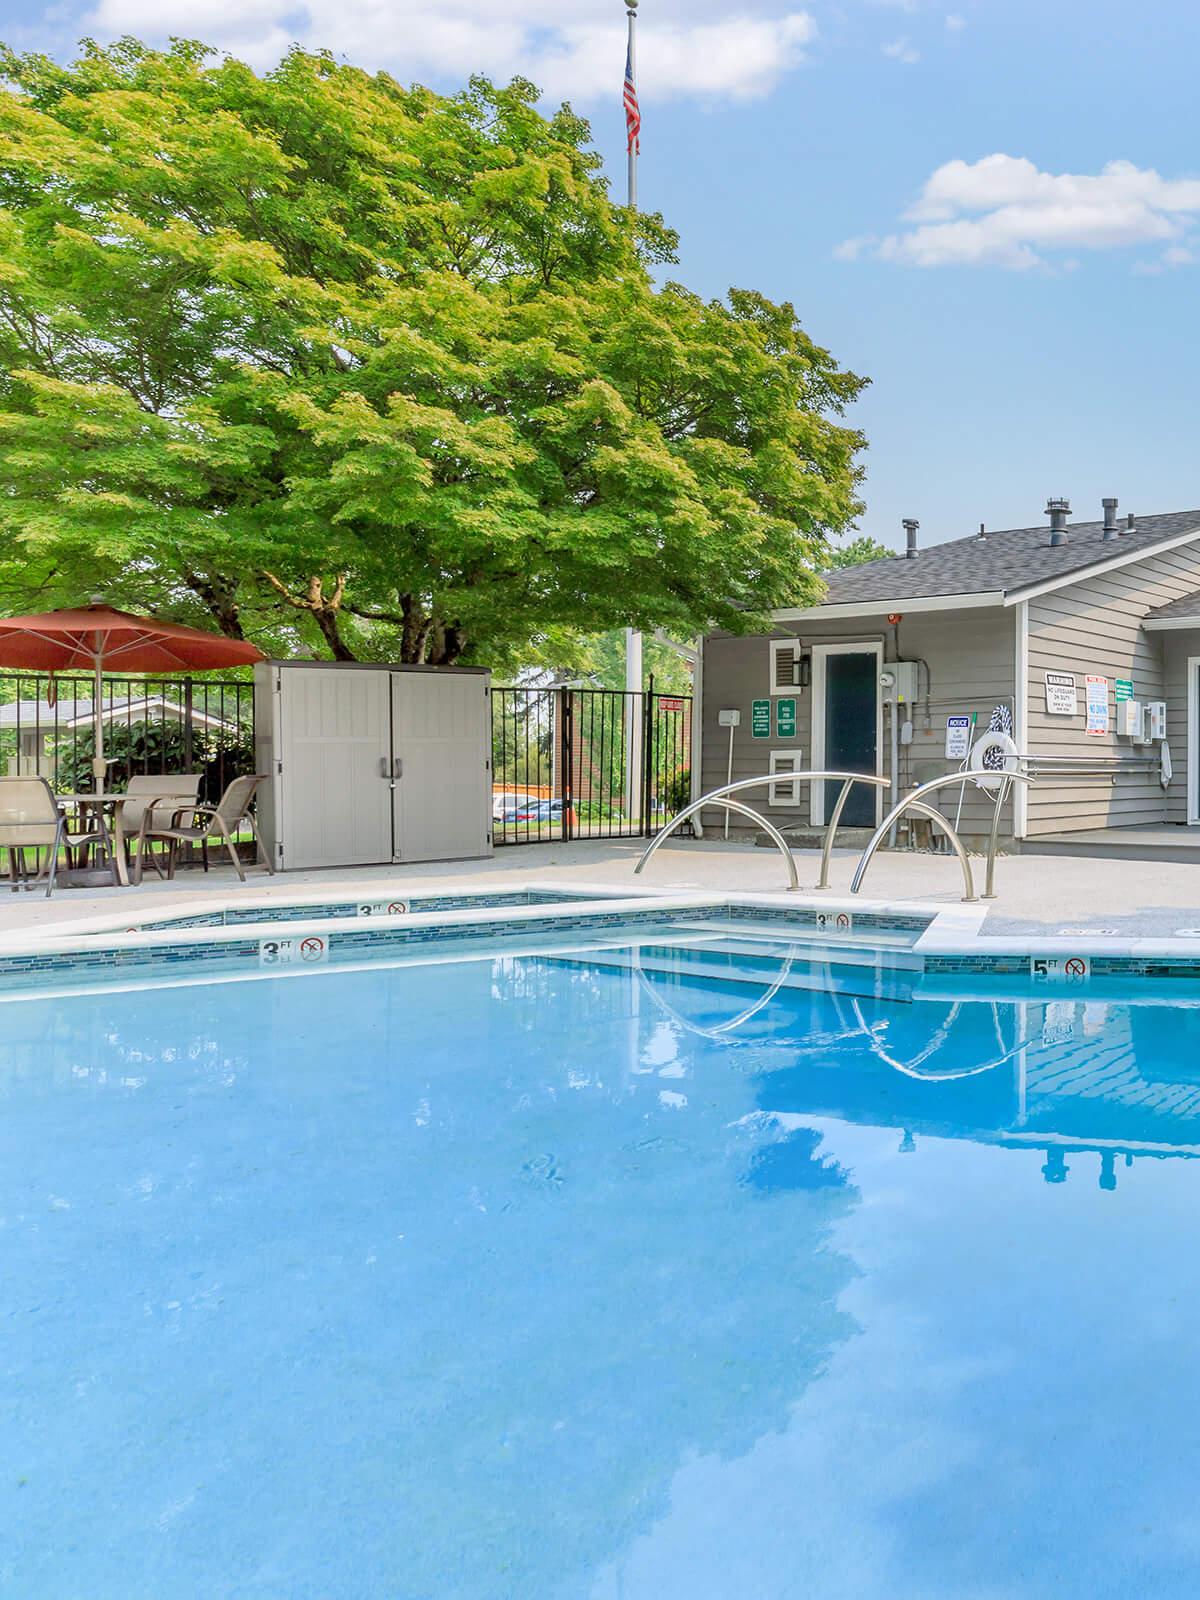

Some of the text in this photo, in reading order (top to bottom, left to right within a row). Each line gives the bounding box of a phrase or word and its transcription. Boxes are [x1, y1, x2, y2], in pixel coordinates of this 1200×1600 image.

[280, 941, 292, 949] FT
[1034, 959, 1058, 975] 5 FT
